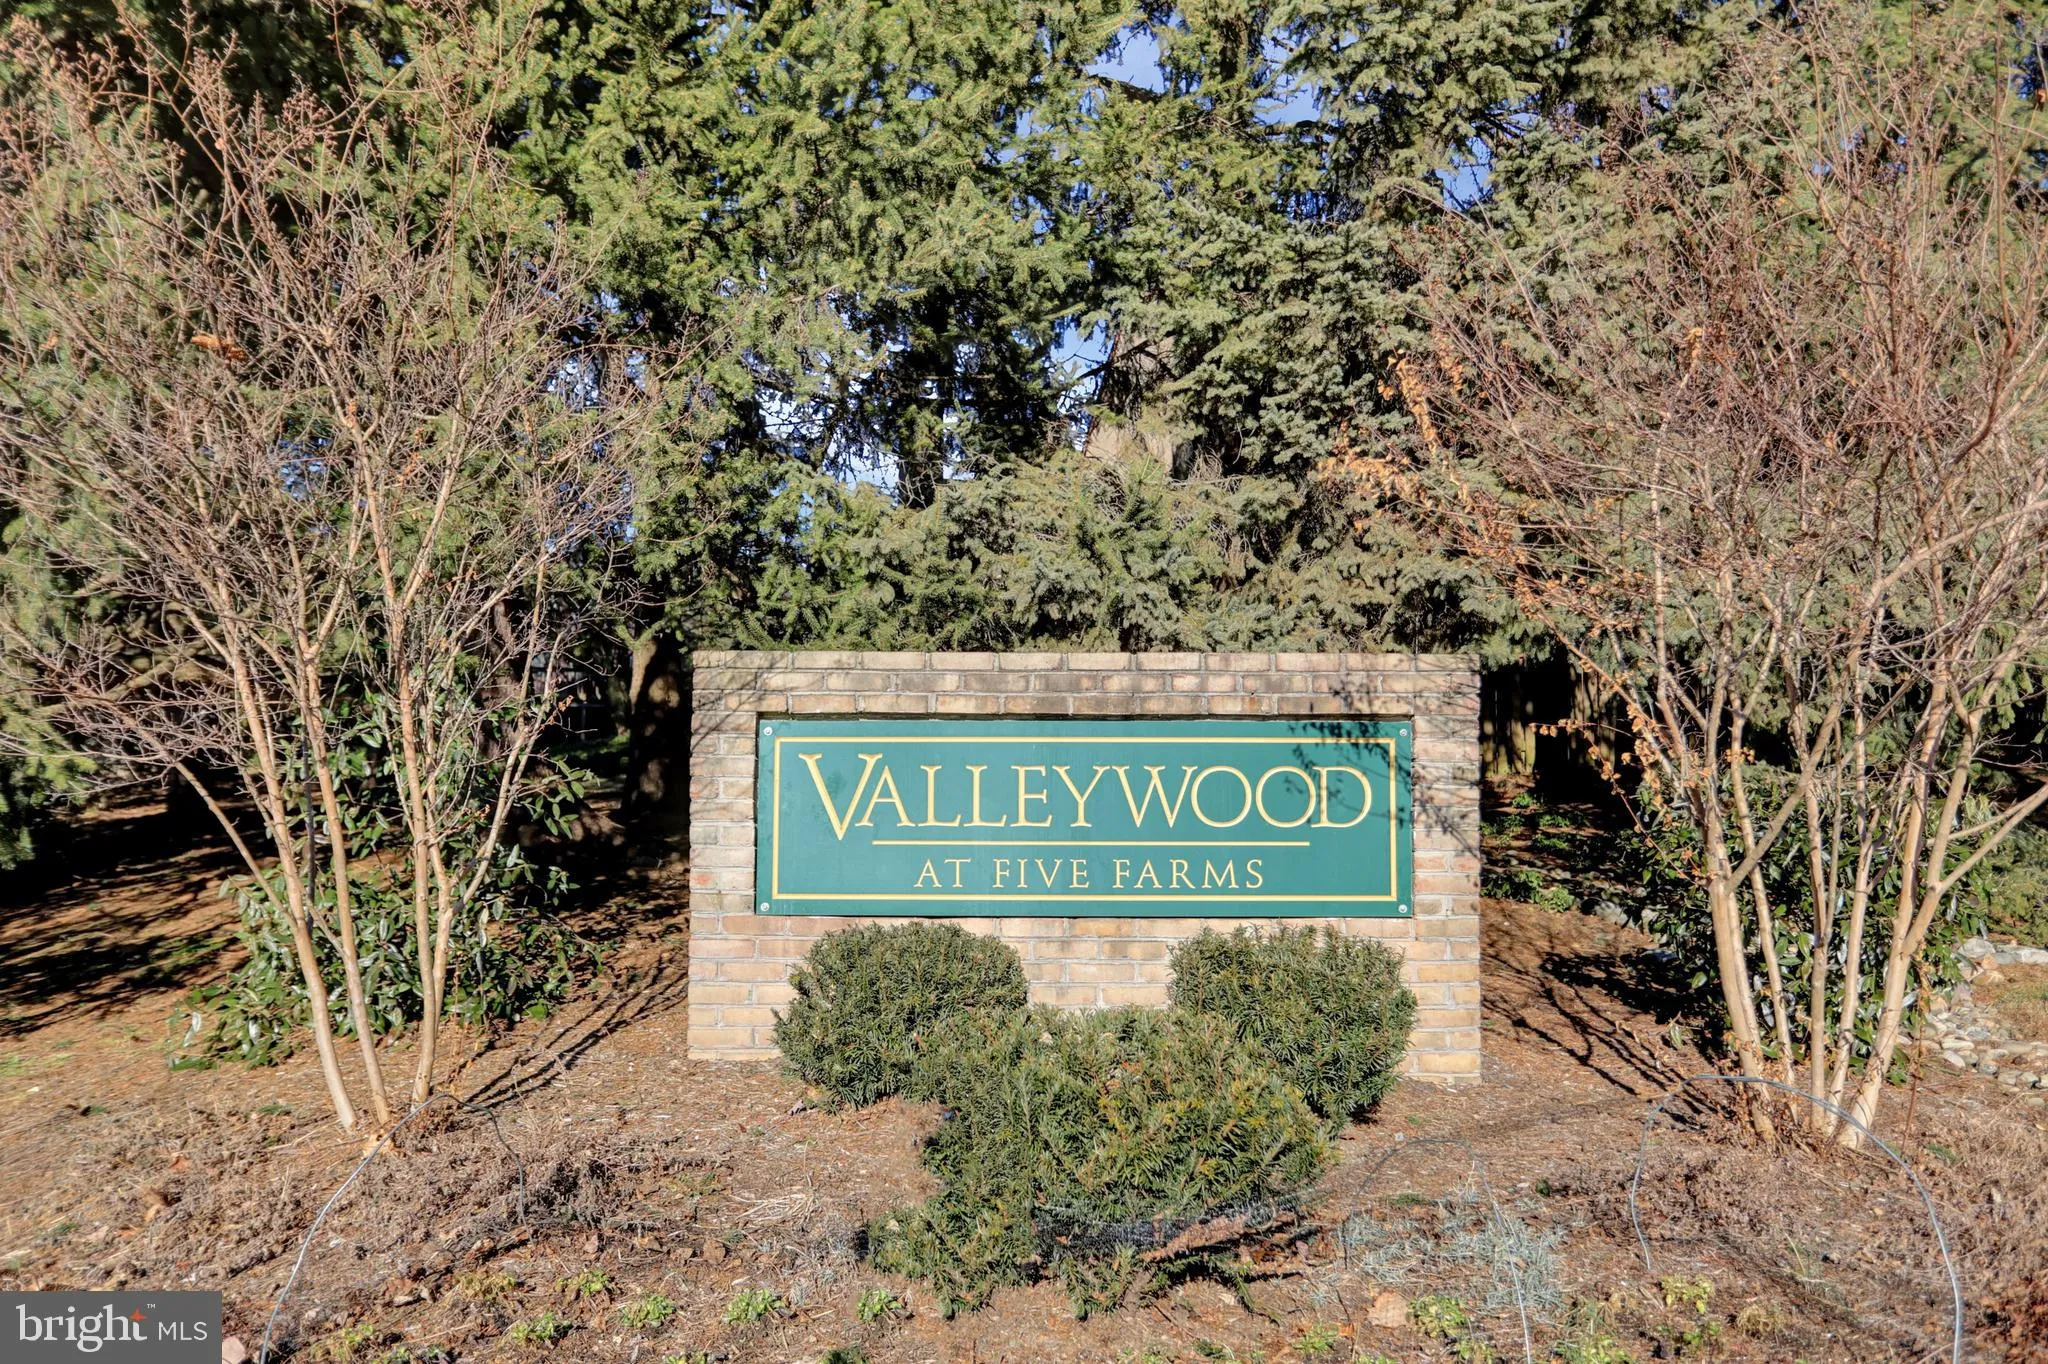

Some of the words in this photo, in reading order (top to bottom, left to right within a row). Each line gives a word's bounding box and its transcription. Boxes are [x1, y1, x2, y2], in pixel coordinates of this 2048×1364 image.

[797, 751, 1373, 841] VALLEYWOOD
[912, 857, 974, 889] AT
[991, 857, 1090, 889] FIVE
[1111, 857, 1264, 890] FARMS
